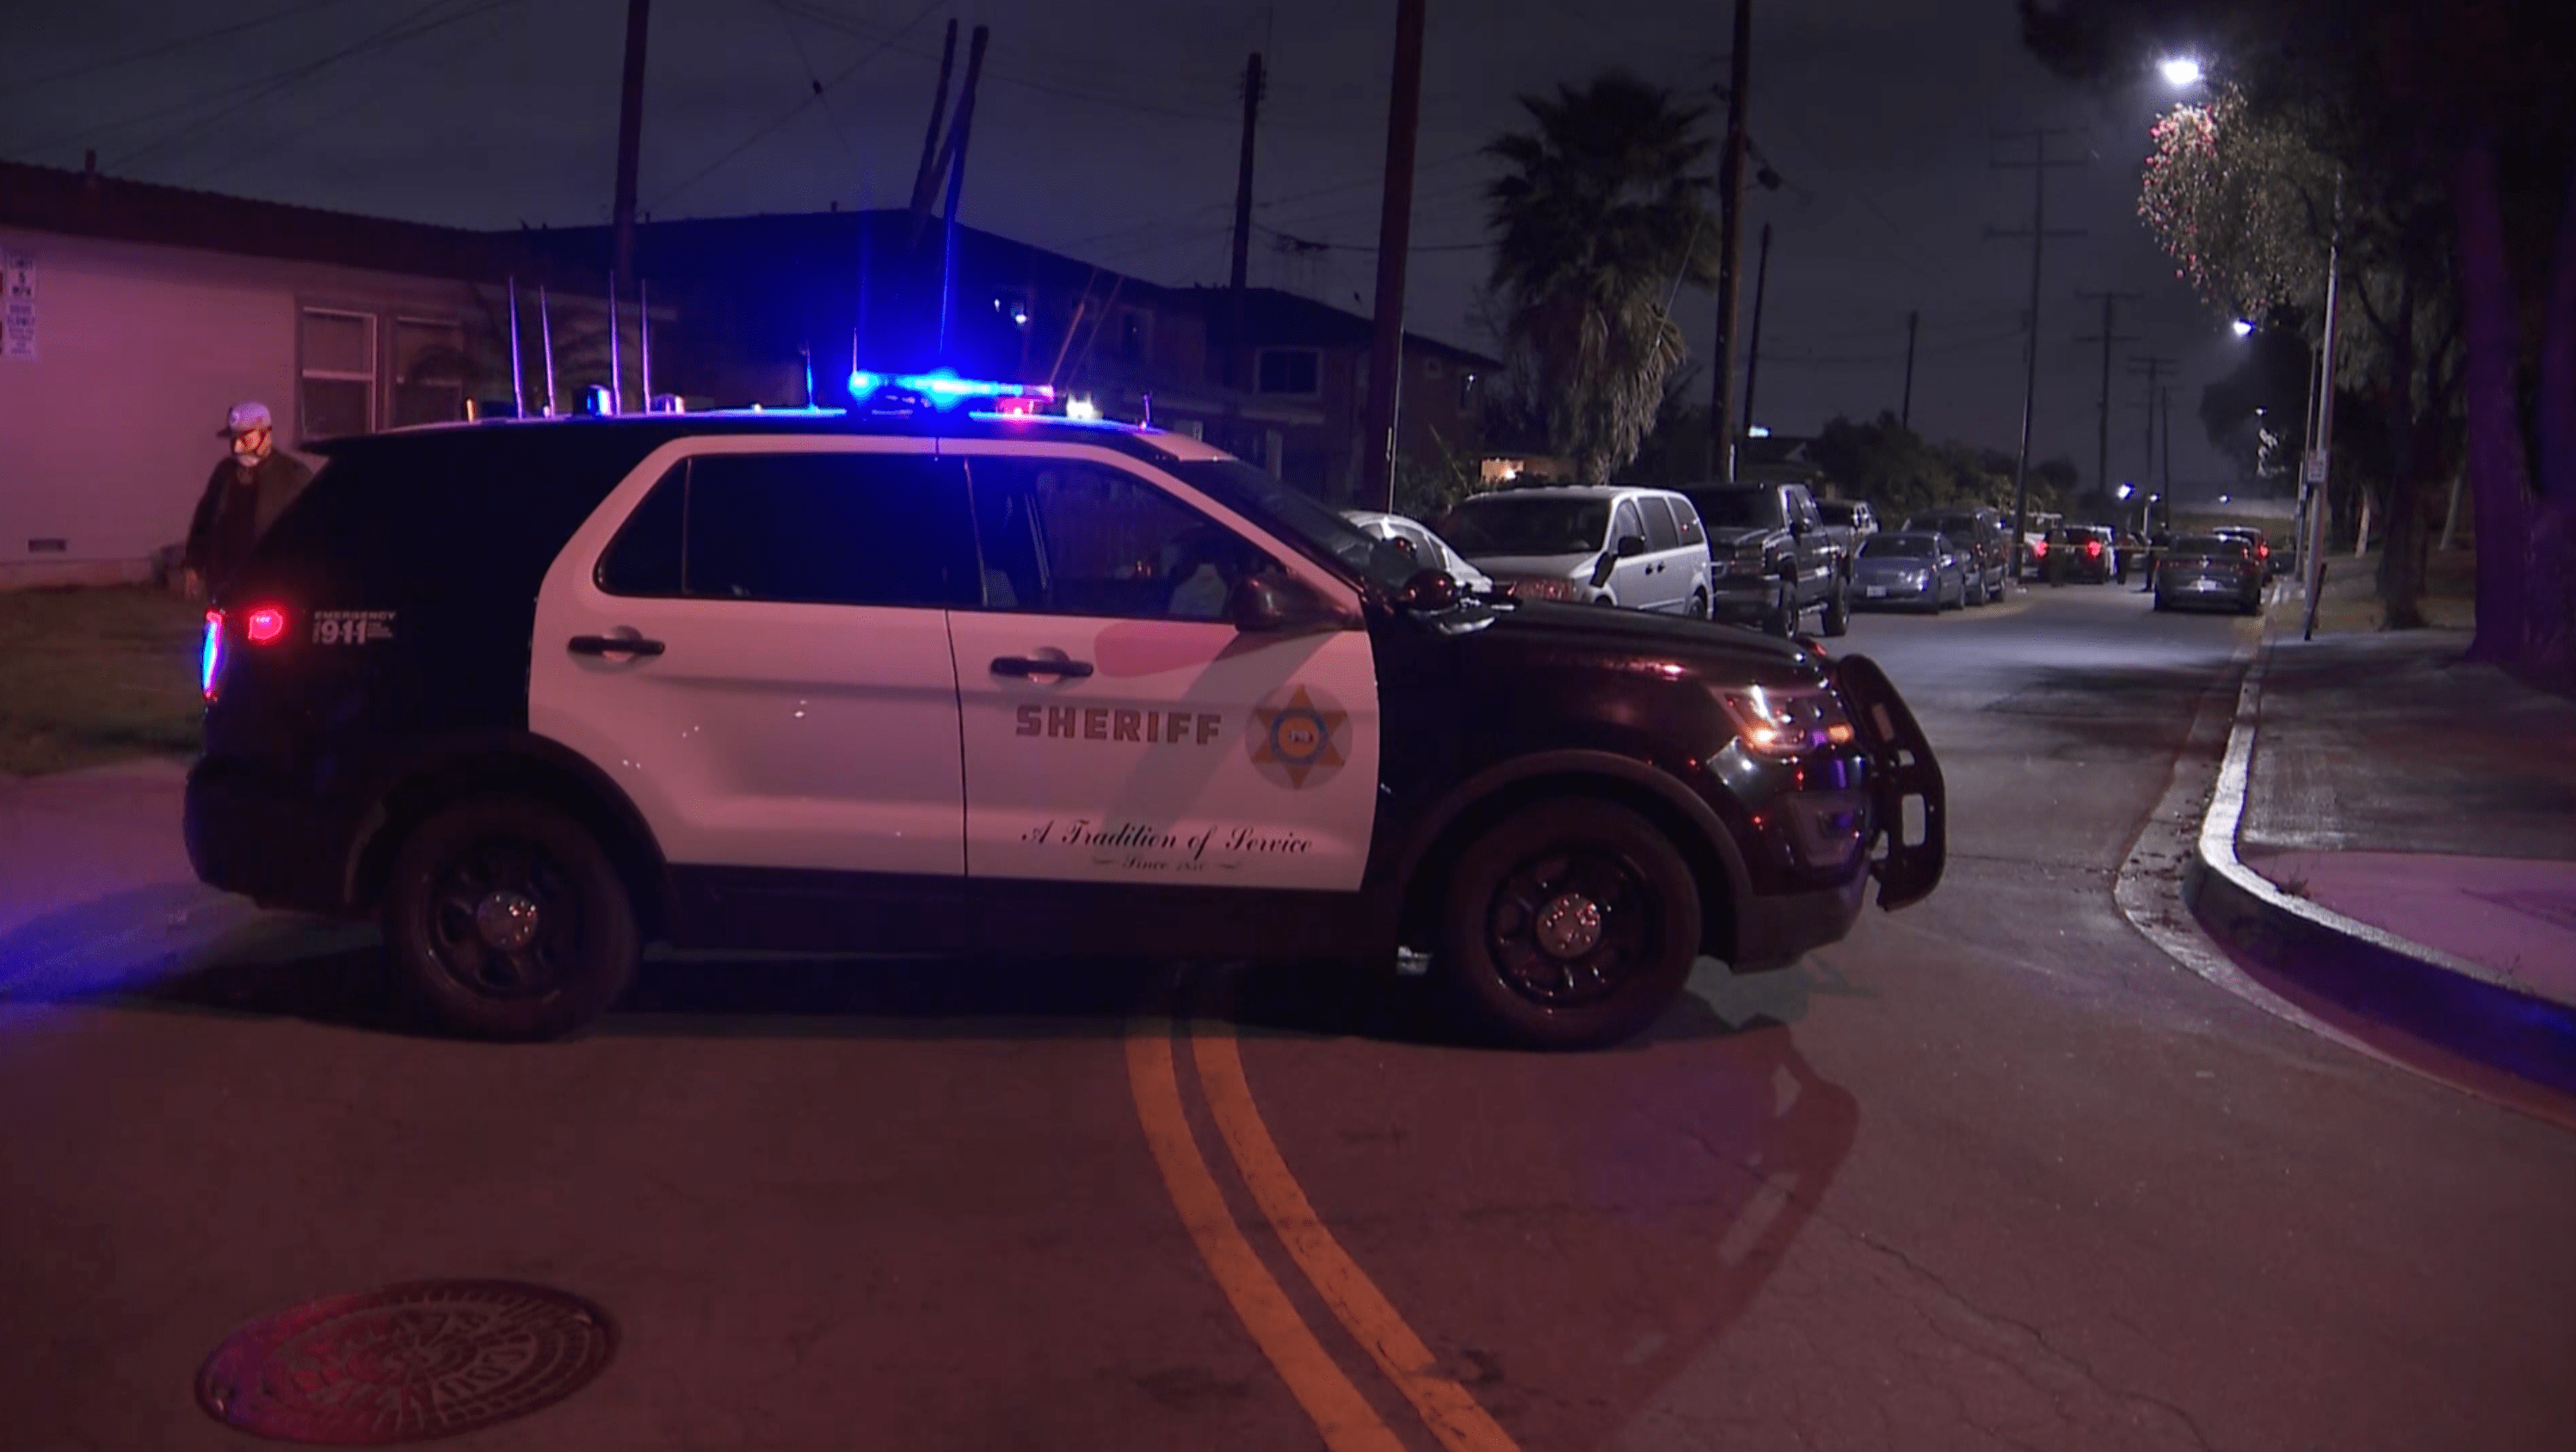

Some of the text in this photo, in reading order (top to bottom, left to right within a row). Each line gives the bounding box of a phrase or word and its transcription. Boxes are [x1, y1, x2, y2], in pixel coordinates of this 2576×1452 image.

[313, 610, 397, 620] EMERGENCY
[1015, 704, 1222, 746] SHERIFF
[1021, 818, 1312, 862] A Tradition of Service
